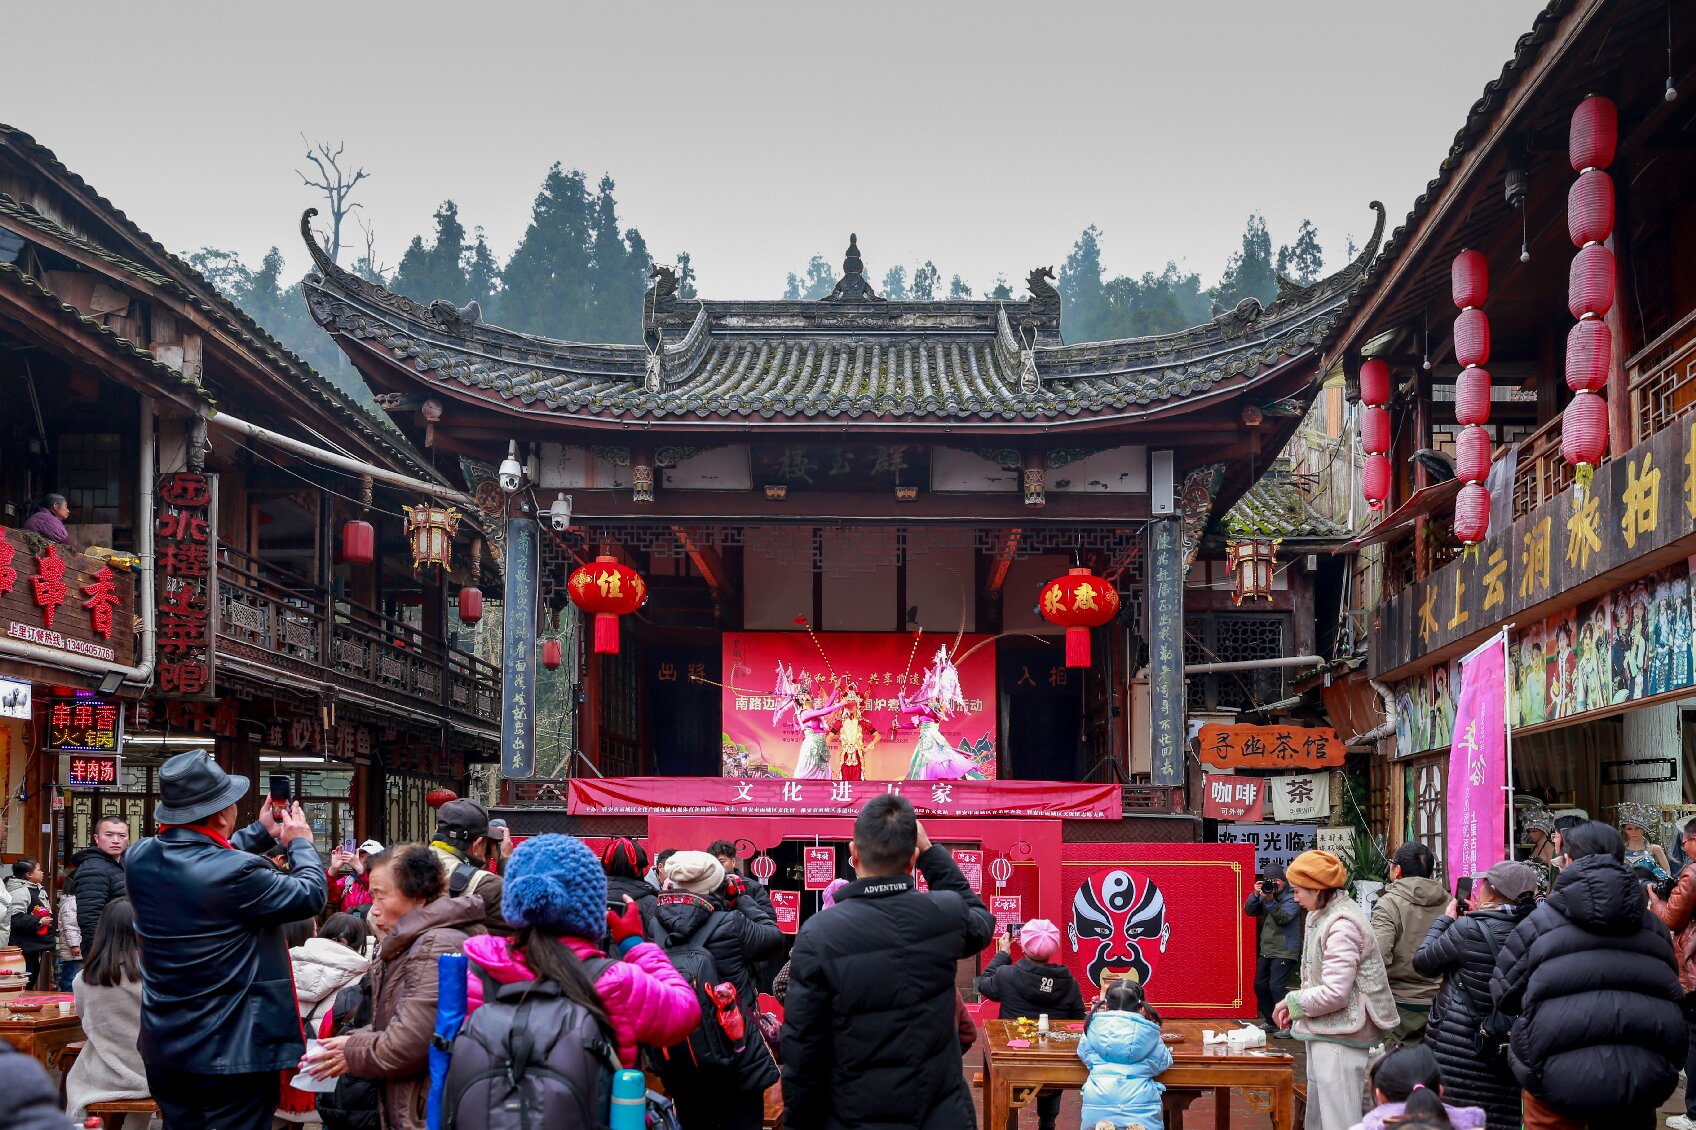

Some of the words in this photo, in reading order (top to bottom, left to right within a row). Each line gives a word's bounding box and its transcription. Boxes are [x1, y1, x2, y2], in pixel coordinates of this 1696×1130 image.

[1044, 582, 1099, 614] 欢度
[1017, 665, 1066, 687] 入相
[53, 702, 116, 730] 串串香
[52, 728, 113, 748] 火锅
[1208, 731, 1329, 760] 寻幽茶馆
[71, 760, 113, 781] 羊肉汤
[1211, 781, 1257, 805] 咖啡
[1286, 779, 1313, 803] 茶
[1220, 807, 1245, 816] 可外带
[864, 883, 907, 893] ADVENTURE
